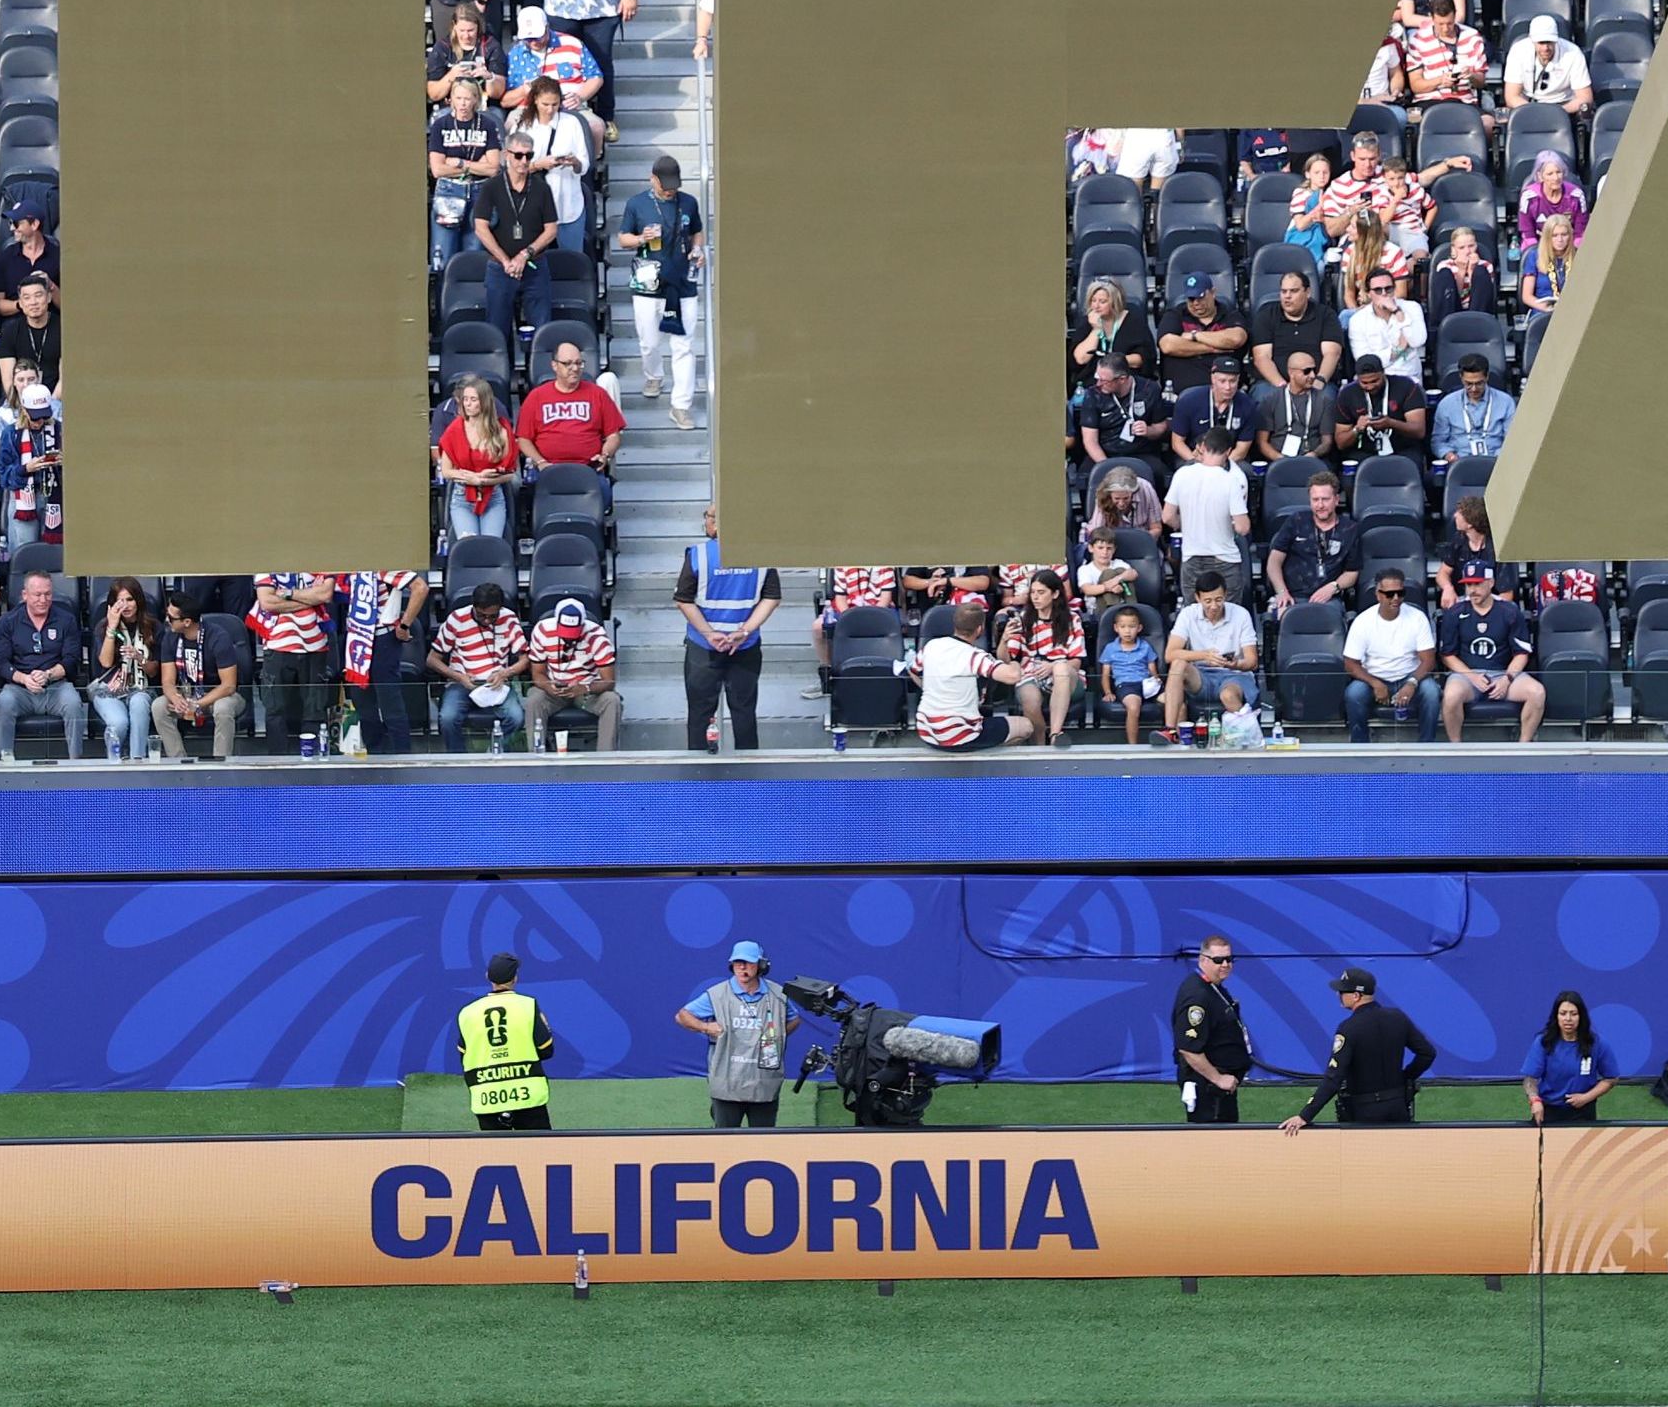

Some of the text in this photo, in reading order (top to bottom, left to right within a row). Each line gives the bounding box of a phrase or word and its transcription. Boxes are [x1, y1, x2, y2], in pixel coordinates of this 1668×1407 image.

[543, 401, 591, 424] LMU
[476, 1064, 532, 1084] SCURITY
[481, 1086, 530, 1106] 08043
[371, 1158, 1099, 1259] CALIFORNIA
